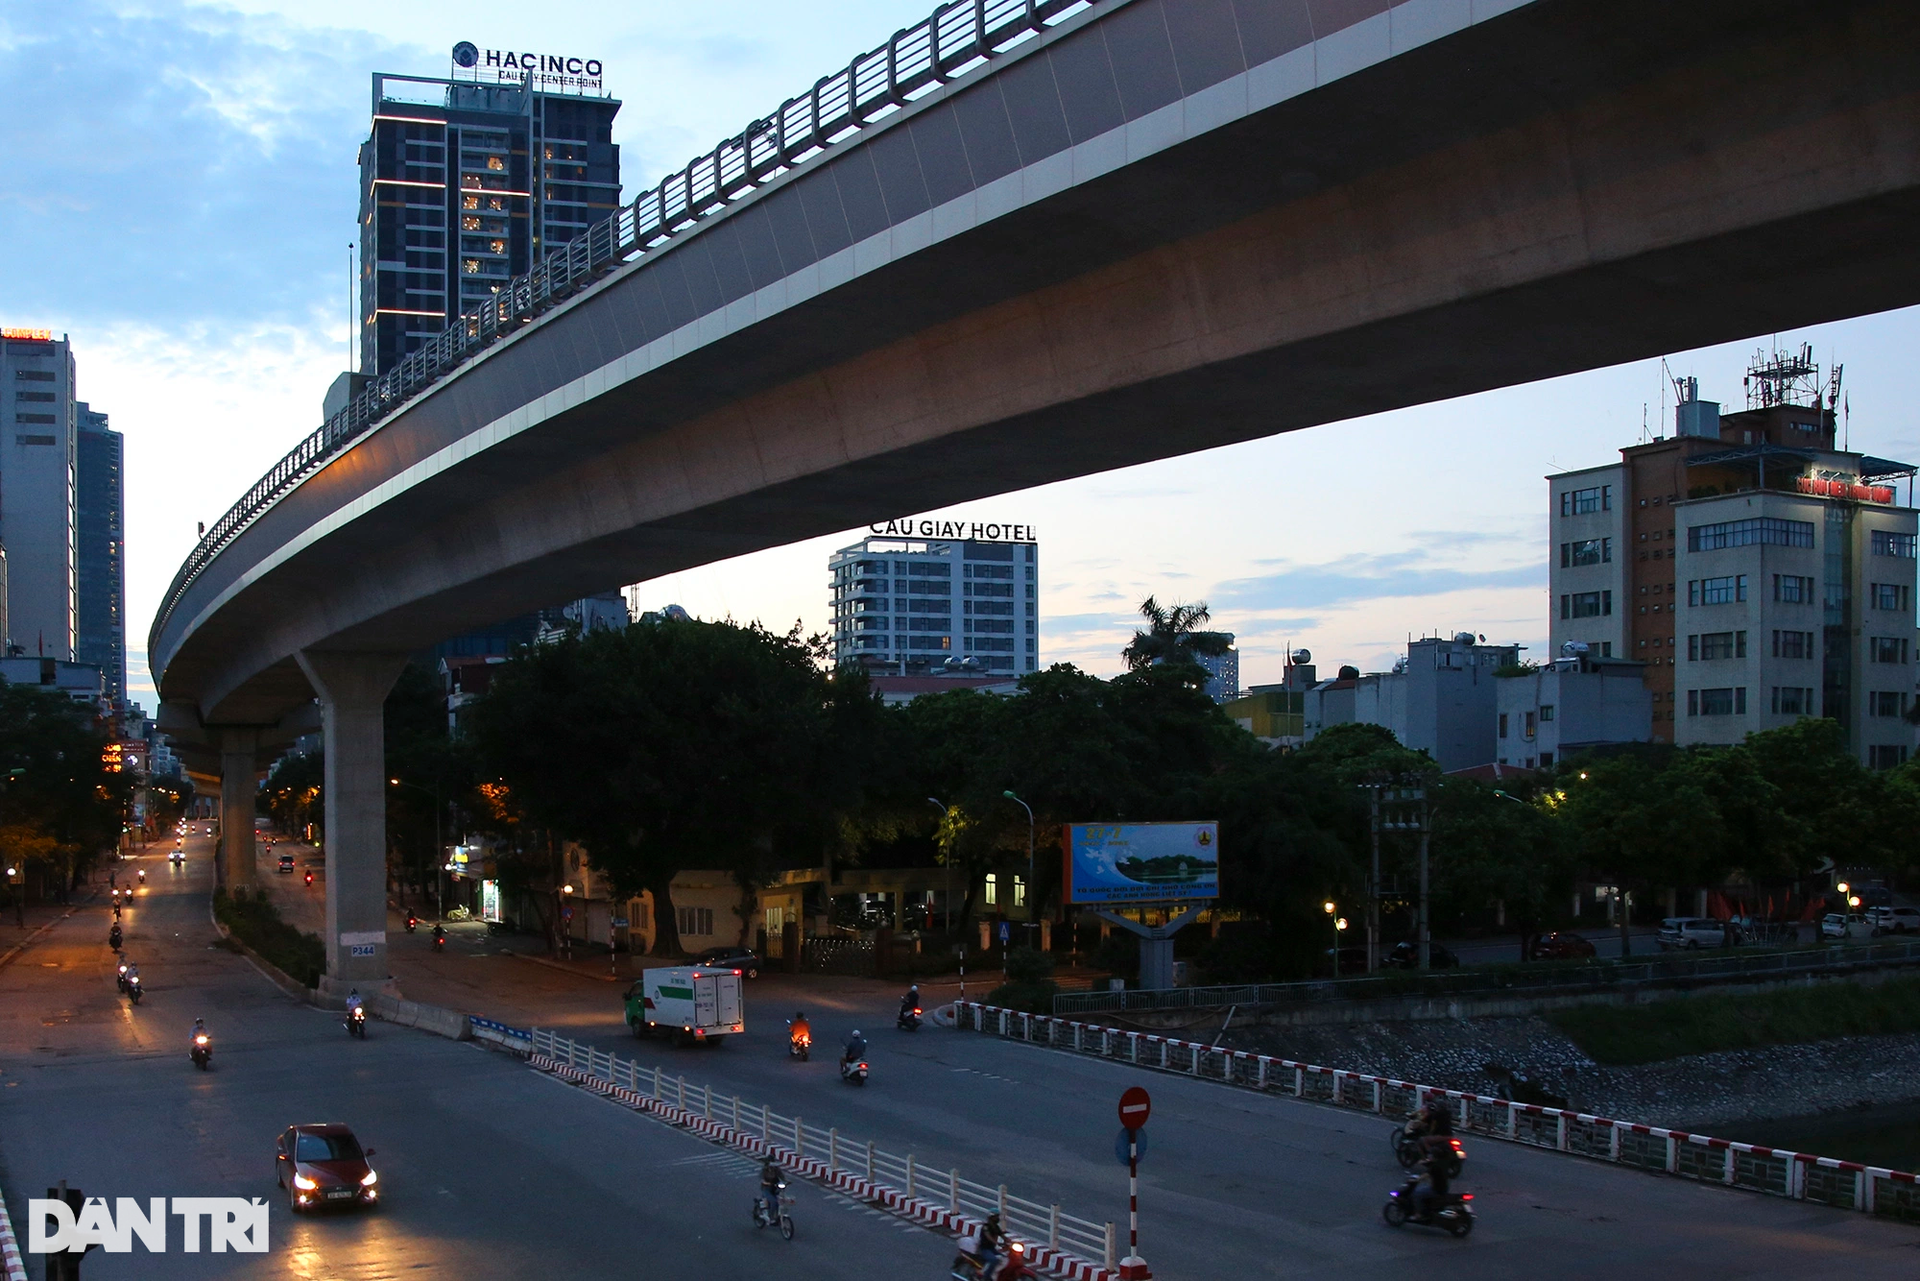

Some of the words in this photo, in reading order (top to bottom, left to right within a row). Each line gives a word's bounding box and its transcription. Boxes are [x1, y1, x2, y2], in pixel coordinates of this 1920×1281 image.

[486, 49, 602, 76] HACINCO
[499, 70, 518, 80] CAU
[541, 74, 575, 85] CENTER
[577, 77, 602, 88] POINT
[4, 327, 51, 340] COMPLEX
[920, 520, 965, 538] GIAY
[971, 523, 1036, 541] HOTEL
[352, 946, 374, 955] P344
